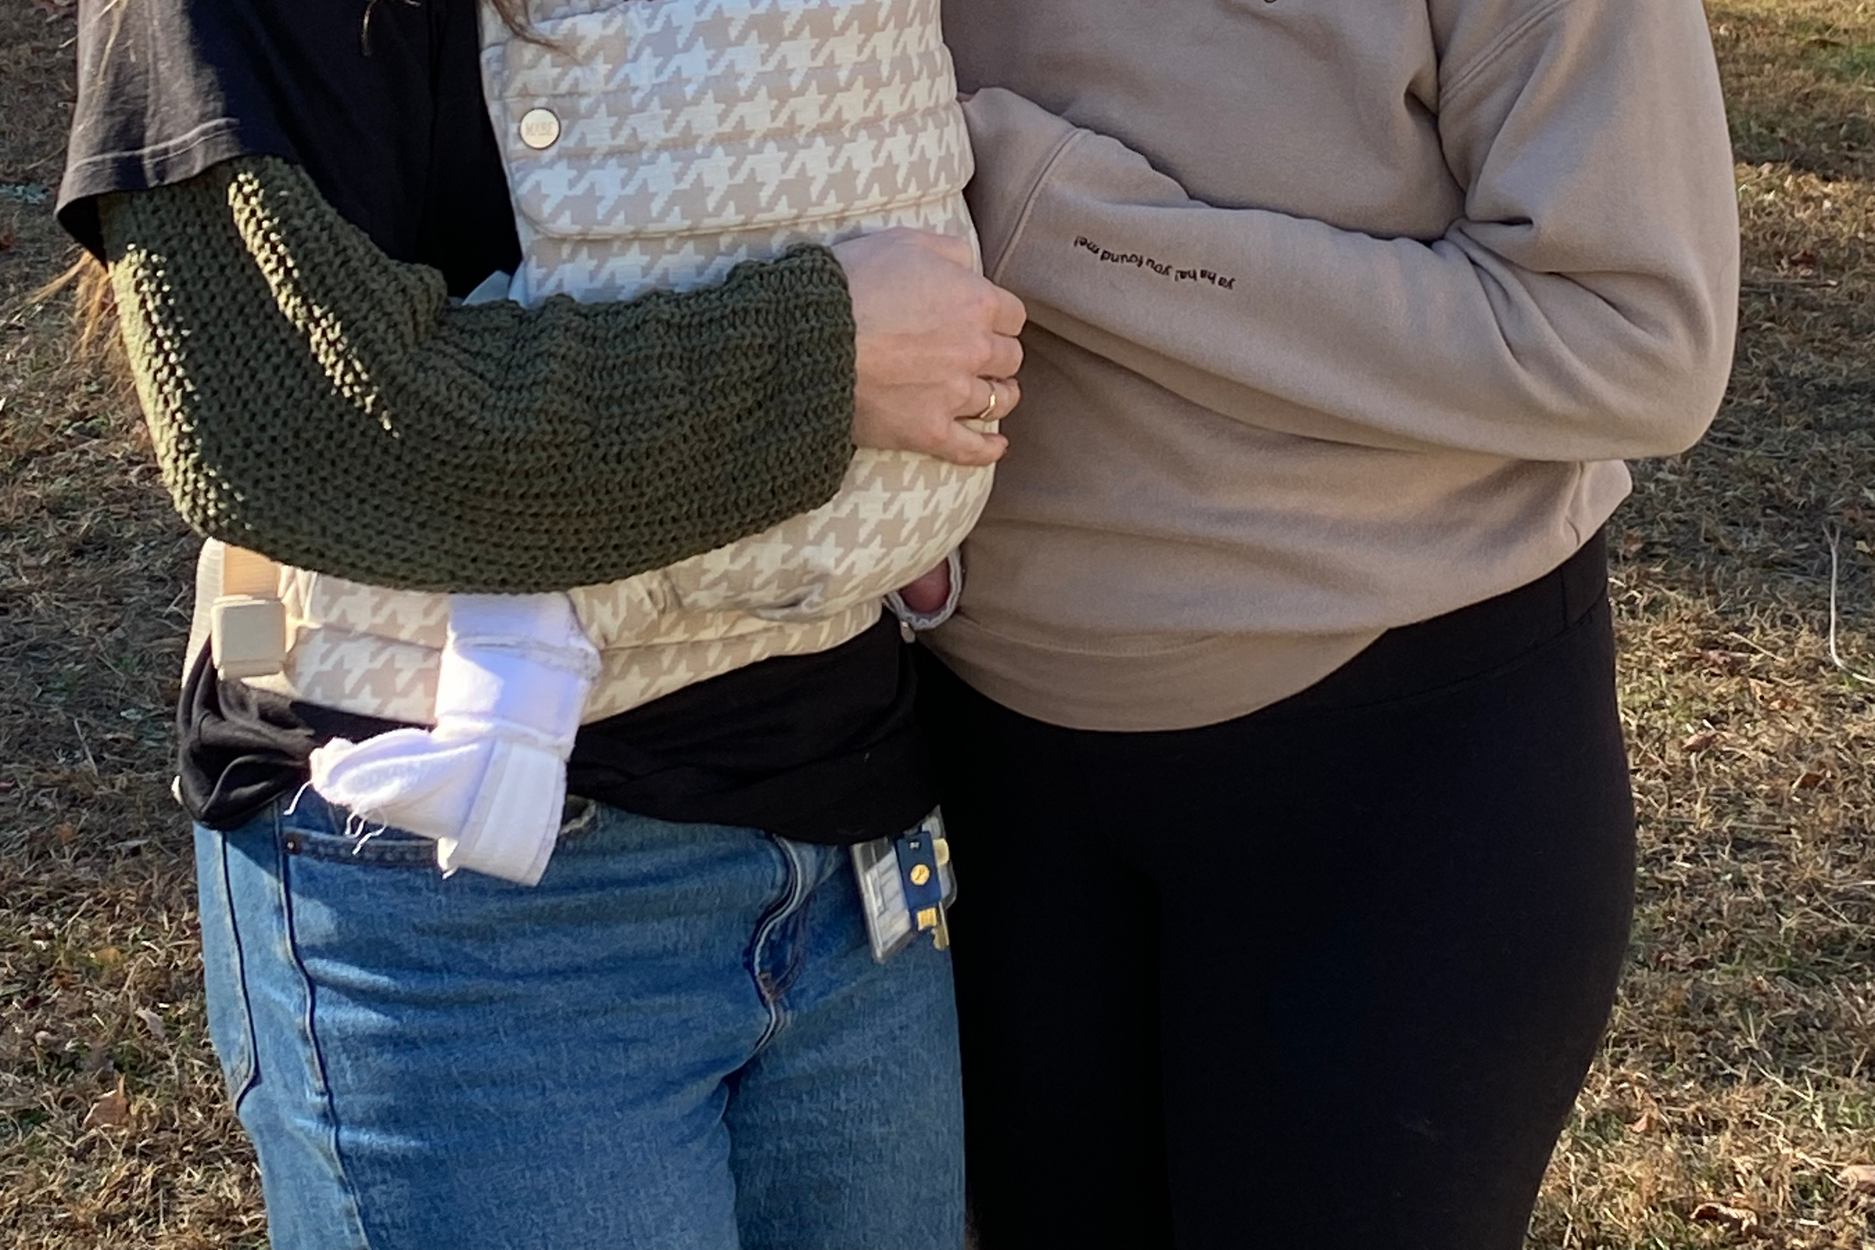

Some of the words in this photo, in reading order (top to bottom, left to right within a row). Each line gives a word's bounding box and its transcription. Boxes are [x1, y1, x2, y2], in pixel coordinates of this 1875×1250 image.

[1073, 236, 1101, 255] me!
[1099, 249, 1144, 268] found
[1145, 258, 1173, 276] you
